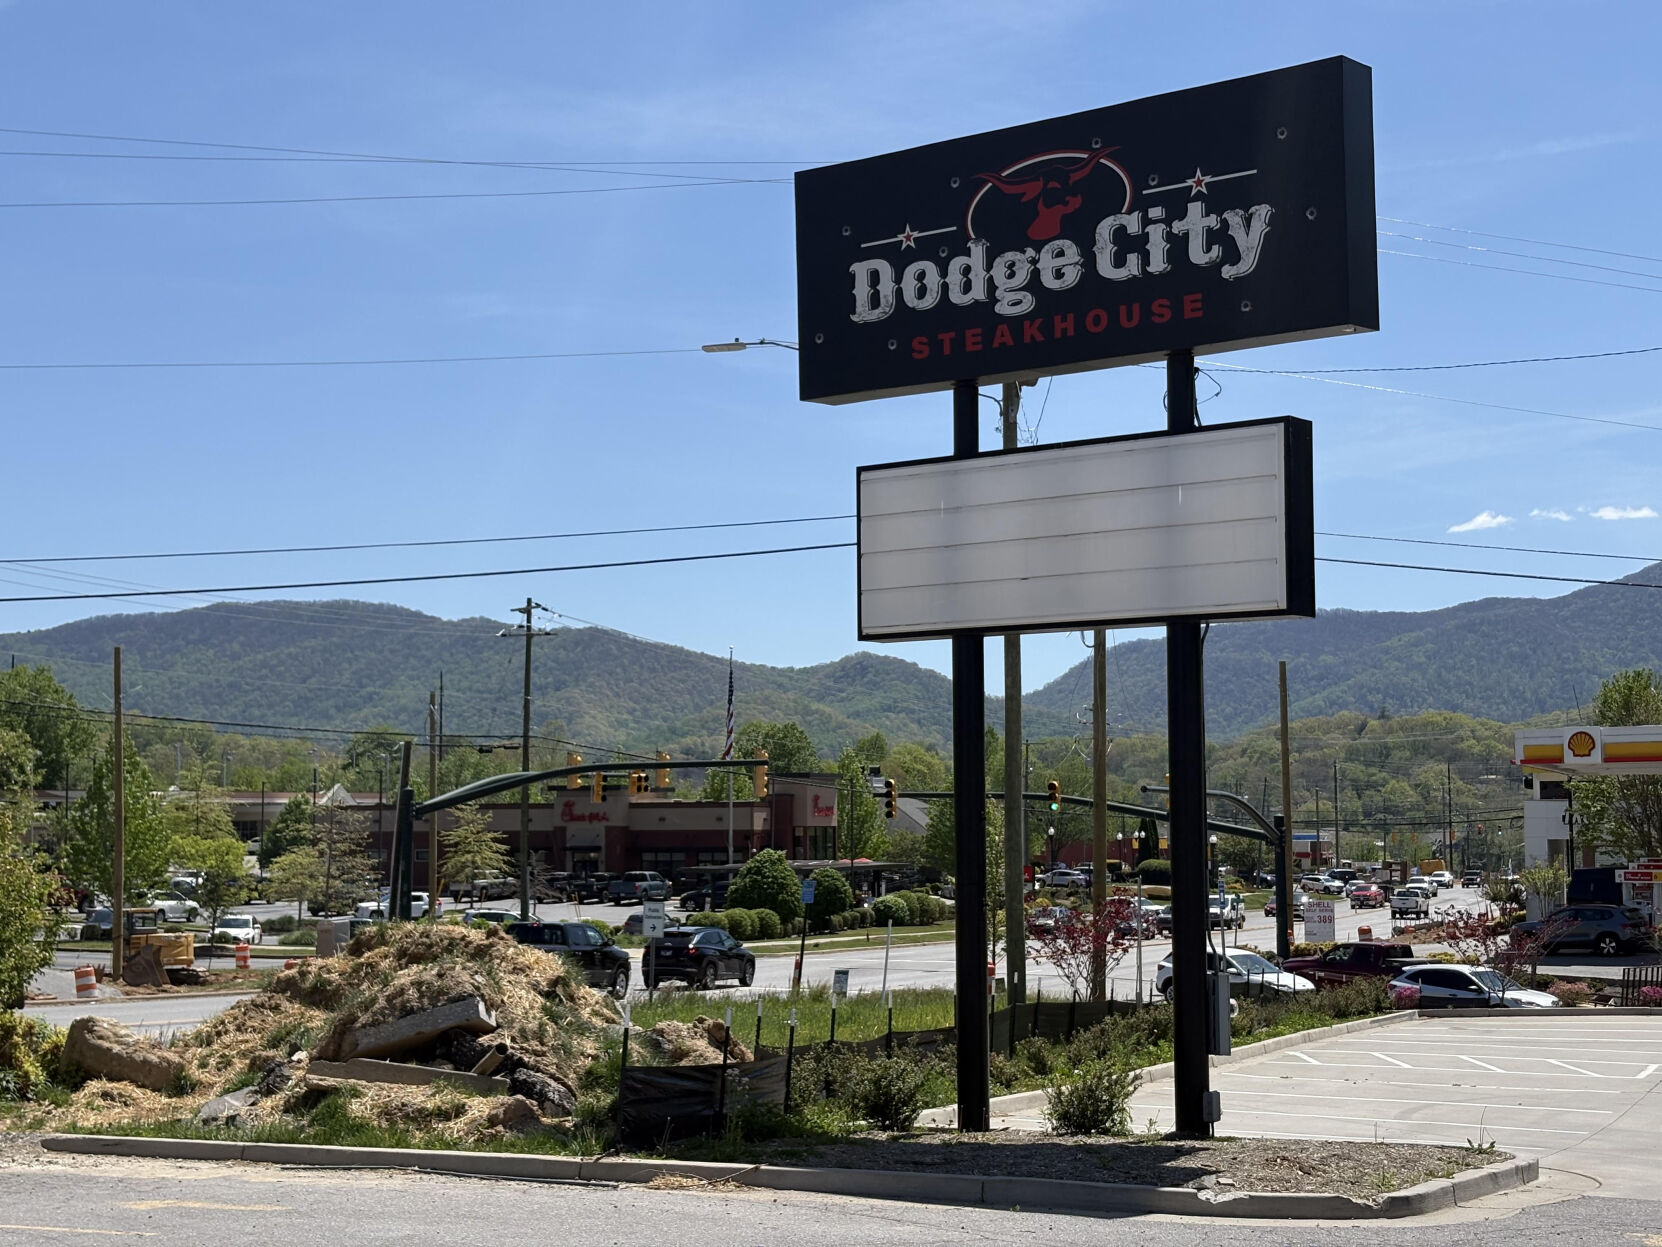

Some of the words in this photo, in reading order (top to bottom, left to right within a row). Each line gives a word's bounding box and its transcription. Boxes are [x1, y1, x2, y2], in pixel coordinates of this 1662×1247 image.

[849, 238, 1085, 323] Dodge
[1094, 200, 1274, 281] City
[911, 293, 1205, 360] STEAKHOUSE
